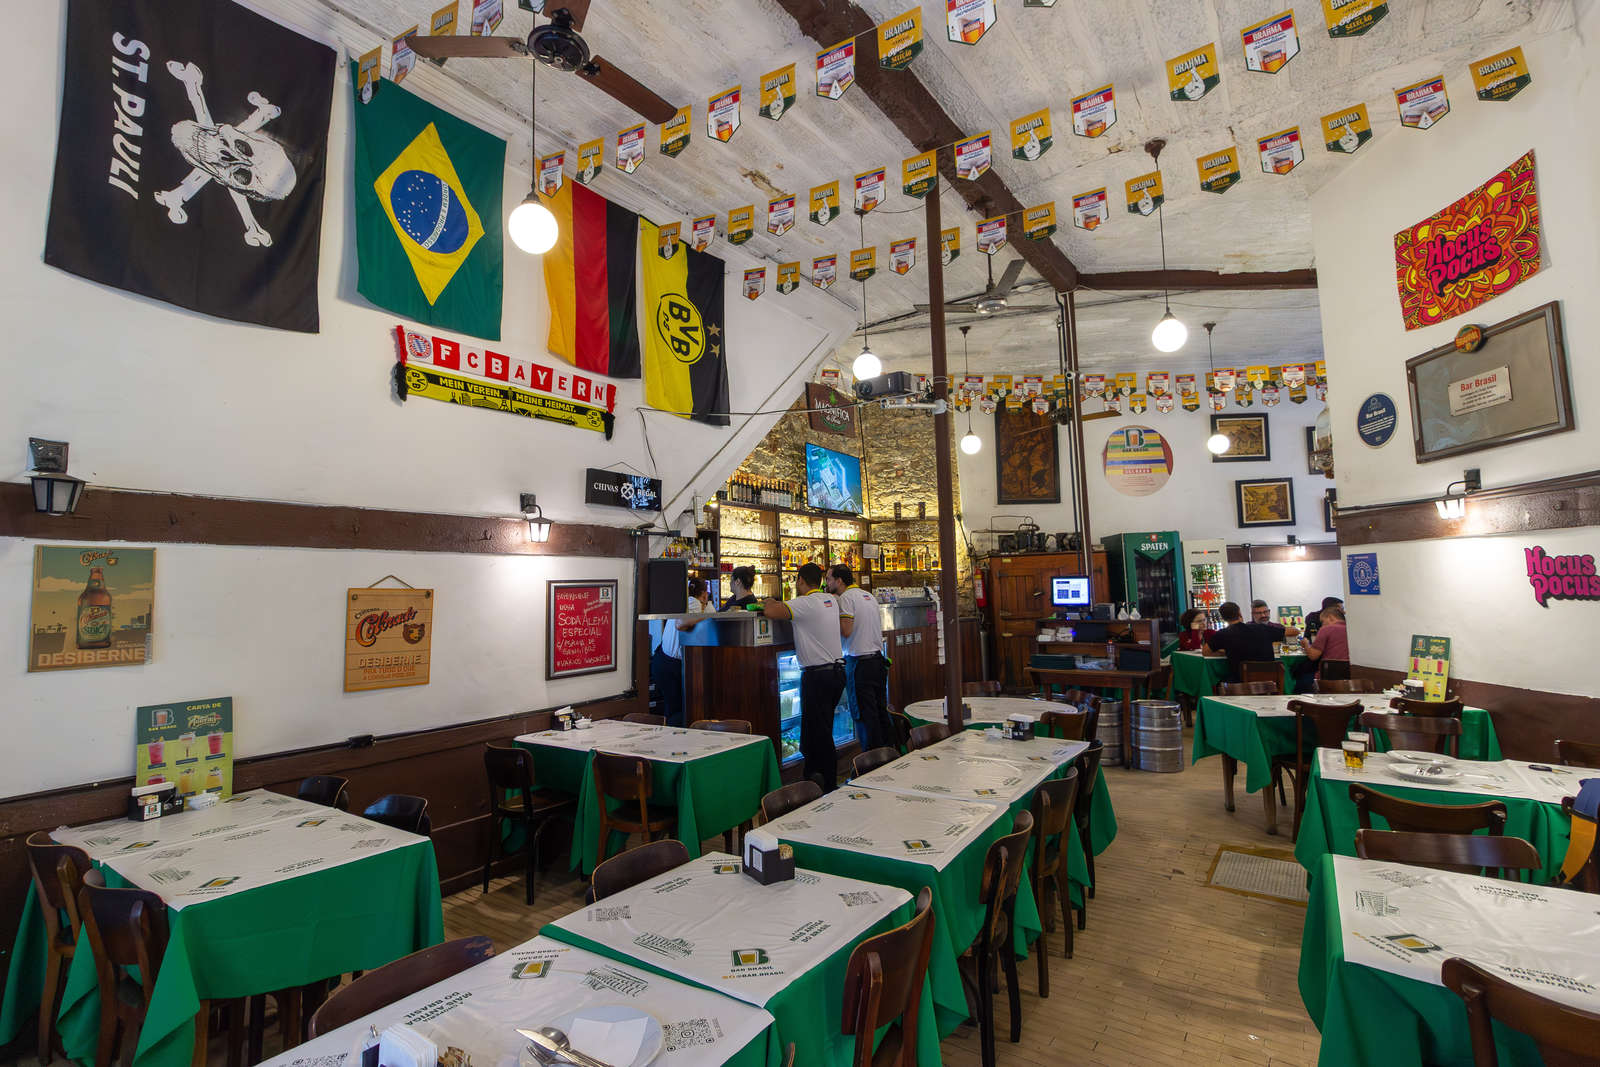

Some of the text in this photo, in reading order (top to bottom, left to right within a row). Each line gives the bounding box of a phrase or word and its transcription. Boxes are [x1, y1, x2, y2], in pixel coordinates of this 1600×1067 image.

[884, 19, 915, 41] BRAHMA
[1252, 24, 1282, 41] BRAHMA
[824, 49, 846, 66] BRAHMA
[1175, 53, 1209, 76] BRAHMA
[1479, 56, 1517, 76] BRAHMA
[1406, 86, 1434, 101] BRAHMA
[1080, 95, 1105, 110] BRAHMA
[109, 31, 150, 199] ST. PAULI
[1328, 112, 1361, 130] BRAHMA
[1015, 118, 1044, 136] BRAHMA
[1267, 136, 1290, 149] BRAHMA
[1202, 155, 1232, 170] BRAHMA
[1130, 178, 1157, 193] BRAHMA
[669, 301, 699, 356] BVB
[411, 372, 426, 389] BVB
[1461, 373, 1497, 391] Bar Brasil
[440, 377, 577, 413] MEIN VEREIN. MEINE HEIMAT.
[593, 482, 657, 498] CHIVAS REGAL
[1141, 542, 1168, 551] SPATEN
[558, 613, 581, 626] SODA
[562, 627, 602, 638] ESPECIAL
[38, 647, 145, 666] DESIBERNE
[360, 655, 422, 669] DESIBERNE
[403, 991, 460, 1018] DO BRASIL
[405, 991, 472, 1025] MAIS ANTIGA
